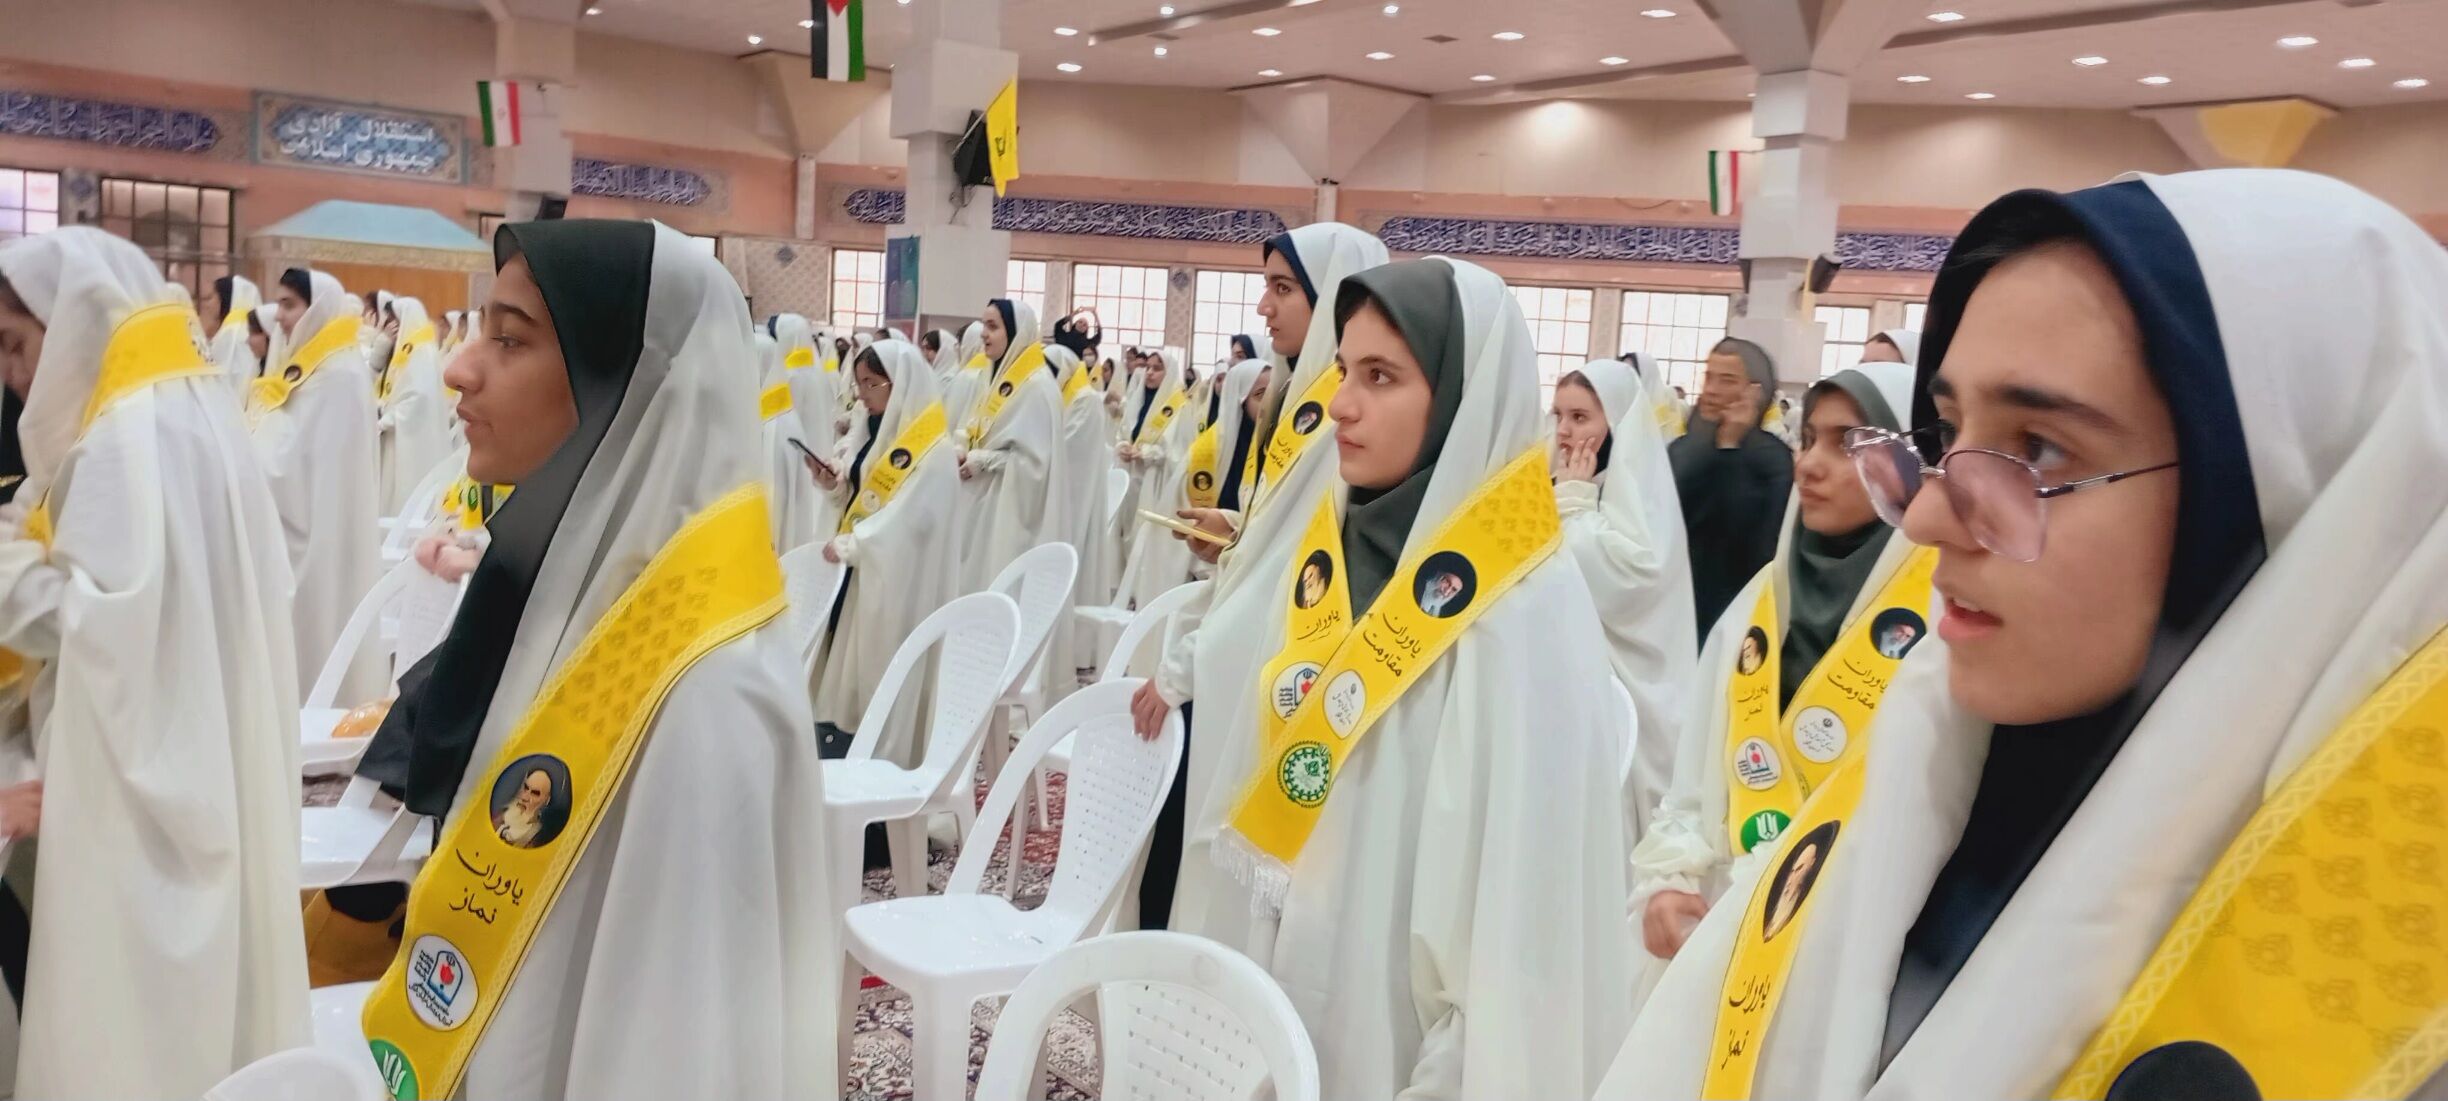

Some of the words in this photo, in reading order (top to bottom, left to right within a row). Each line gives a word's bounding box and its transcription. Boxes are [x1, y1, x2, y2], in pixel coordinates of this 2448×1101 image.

[288, 111, 343, 137] آزادی
[356, 119, 434, 142] استقلال
[280, 137, 348, 159] اسلامی
[354, 149, 436, 173] جمهوری
[1296, 610, 1340, 640] یاوران
[1382, 612, 1421, 659] یاوران
[1363, 630, 1402, 677] مقاومت
[1827, 672, 1875, 709] مقاومت
[1843, 658, 1888, 693] یاوران
[455, 848, 523, 906] یاوران
[449, 886, 497, 924] نماز
[1729, 974, 1770, 1014] یاوران
[1721, 1028, 1749, 1070] نماز
